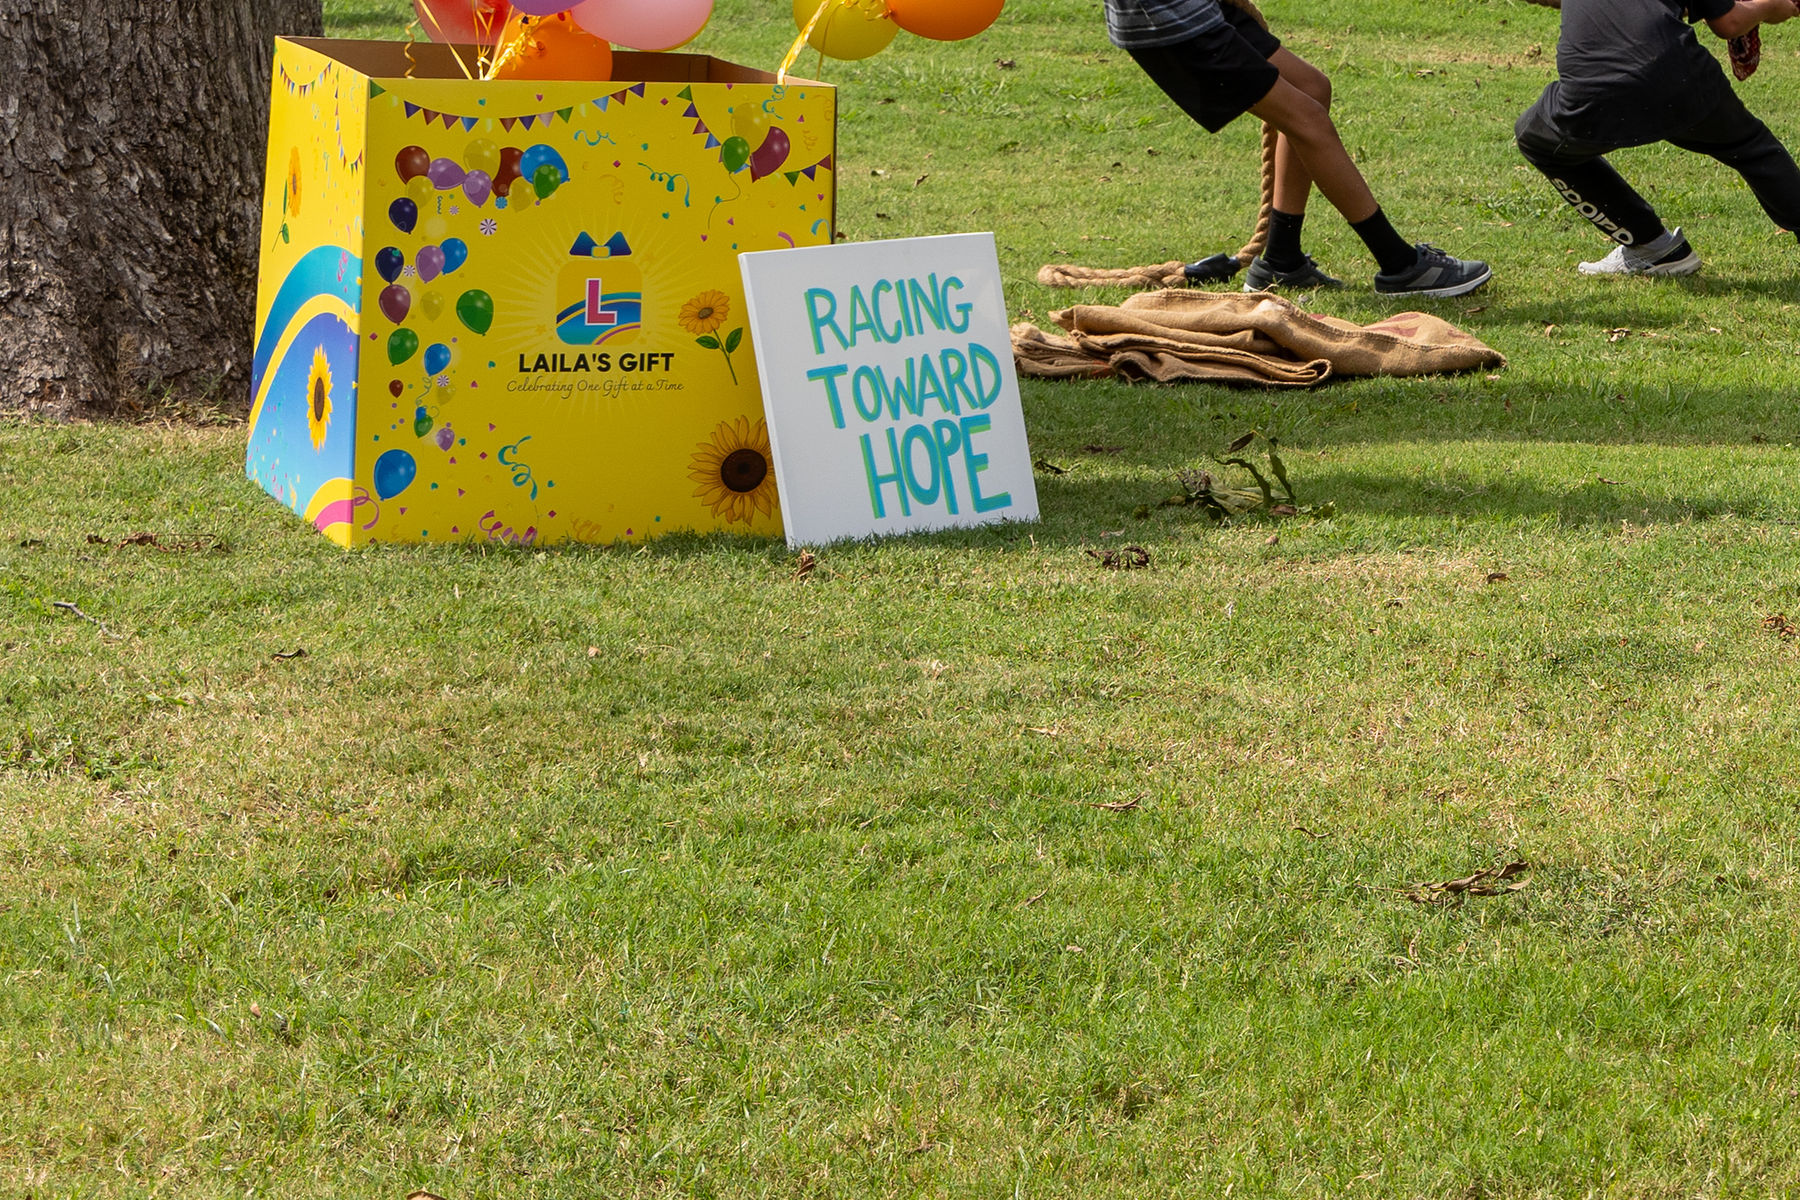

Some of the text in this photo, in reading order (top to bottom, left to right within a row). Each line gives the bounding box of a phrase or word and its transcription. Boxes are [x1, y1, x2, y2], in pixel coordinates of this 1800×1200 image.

[585, 278, 618, 326] L
[804, 272, 973, 355] RACING
[506, 376, 685, 399] Celebrating One Gift at a Time
[518, 353, 675, 373] LAILA'S GIFT
[806, 342, 1003, 429] TOWARD
[859, 413, 1012, 519] HOPE
